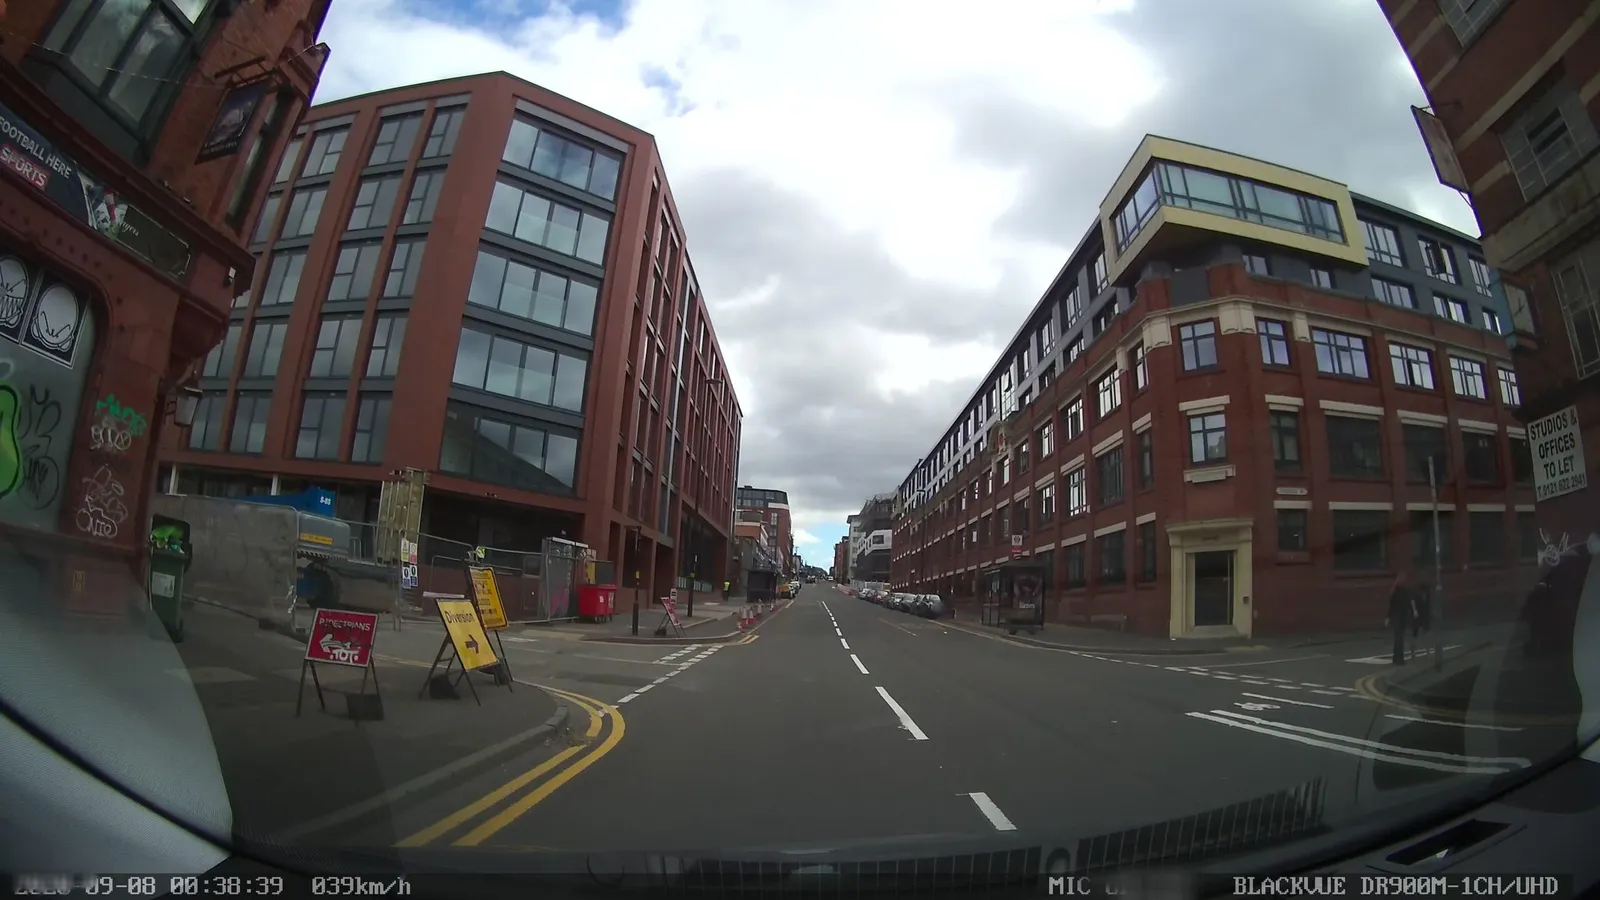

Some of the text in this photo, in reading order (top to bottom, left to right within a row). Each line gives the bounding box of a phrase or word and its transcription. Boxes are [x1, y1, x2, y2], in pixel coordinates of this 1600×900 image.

[0, 147, 47, 187] SPORTS
[45, 152, 72, 179] HERE
[1530, 409, 1578, 440] STUDIOS &
[1538, 432, 1576, 459] OFFICES
[1544, 455, 1575, 480] TO LET
[444, 609, 476, 624] Diversion
